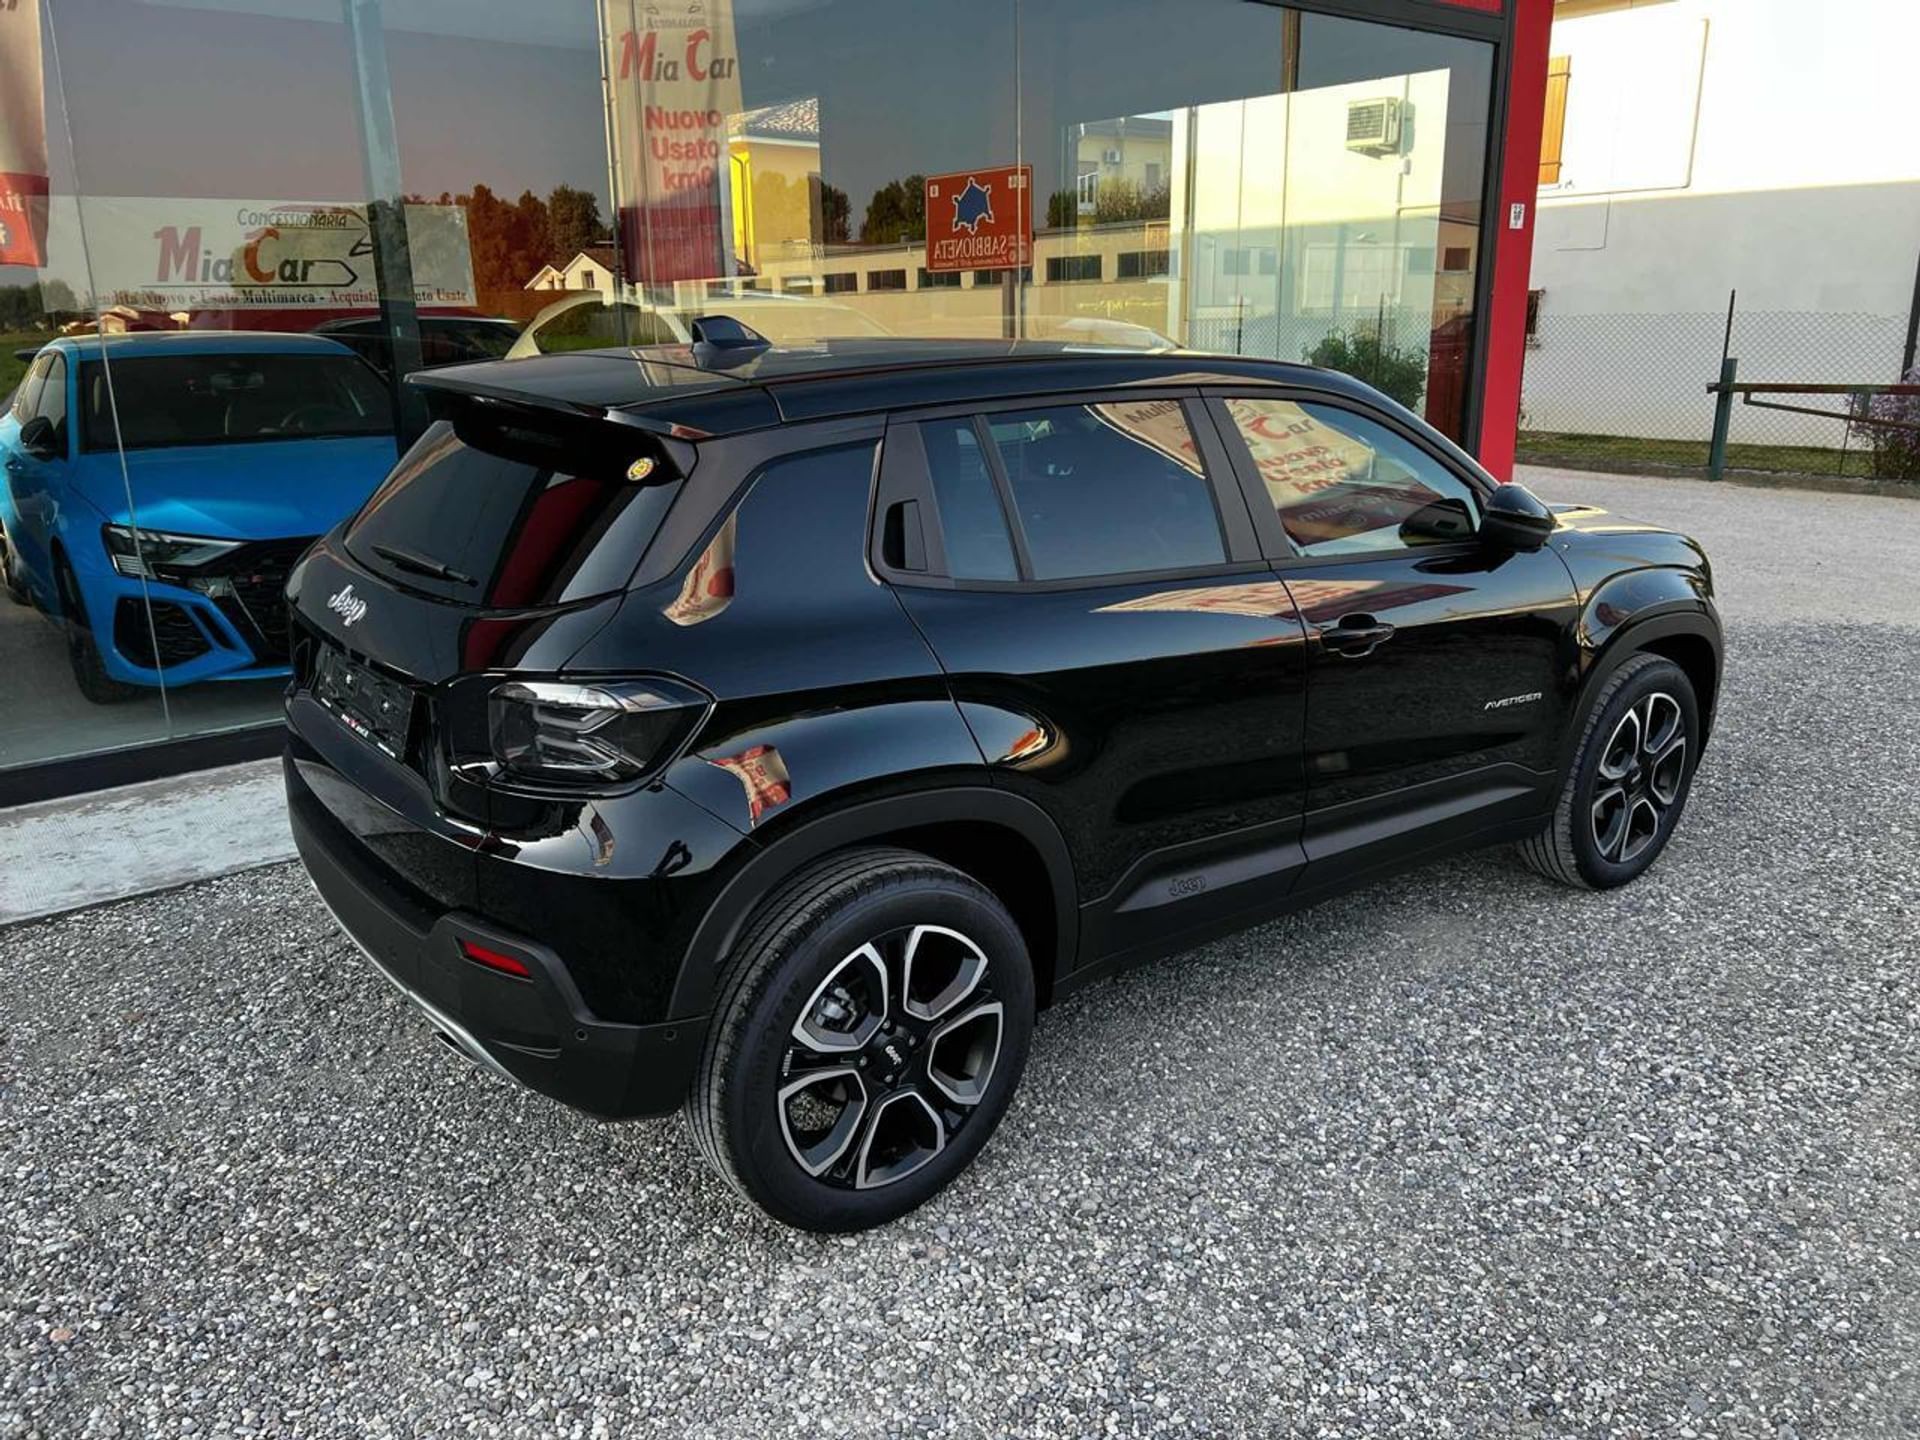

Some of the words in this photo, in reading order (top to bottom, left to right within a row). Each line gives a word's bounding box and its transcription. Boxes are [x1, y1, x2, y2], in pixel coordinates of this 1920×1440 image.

[619, 31, 679, 82] Mia
[686, 29, 735, 81] Car
[645, 106, 722, 131] Nuovo
[651, 137, 719, 161] Usato
[153, 226, 235, 283] Mia
[243, 226, 315, 283] Car
[242, 289, 316, 304] Multimarca
[327, 584, 369, 627] Jeep
[1483, 691, 1542, 711] AVENGER
